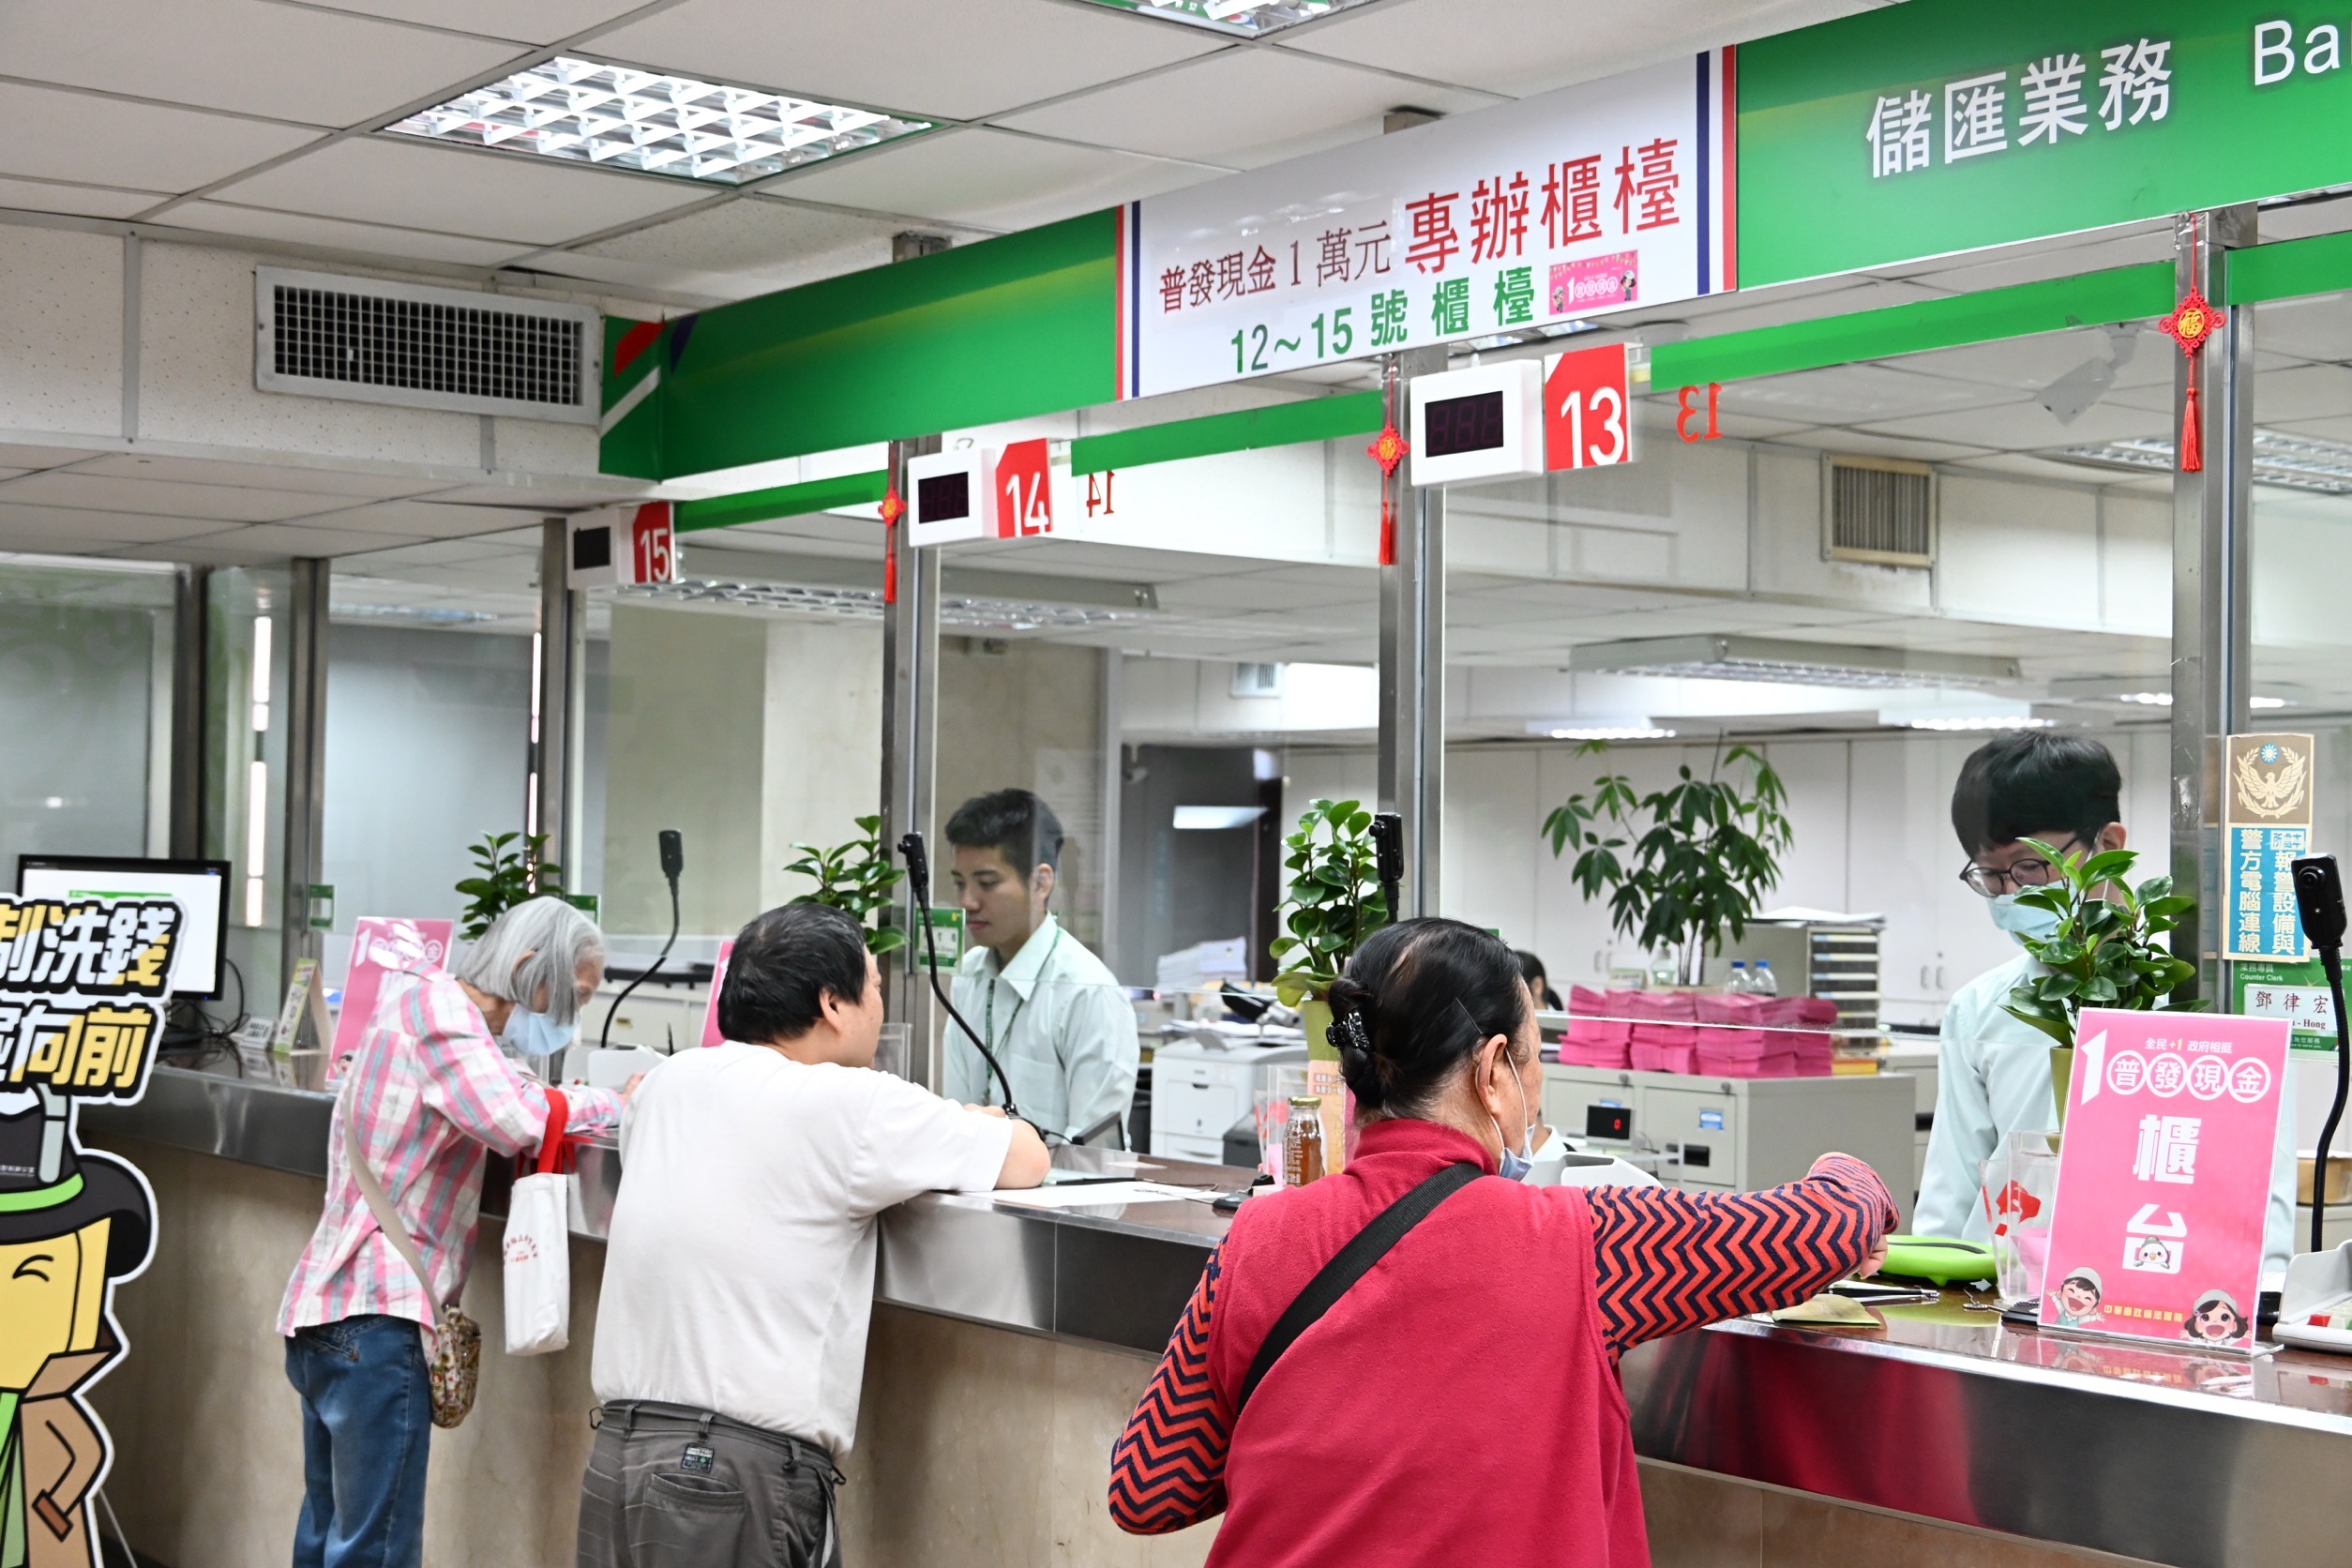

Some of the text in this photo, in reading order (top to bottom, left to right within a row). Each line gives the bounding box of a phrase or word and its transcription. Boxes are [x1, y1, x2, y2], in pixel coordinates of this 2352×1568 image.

[2254, 19, 2352, 86] Ba
[1866, 38, 2173, 178] 儲匯業務
[1406, 137, 1680, 275] 專辦櫃檯
[1560, 385, 1625, 470] 13
[1005, 472, 1050, 537] 14
[641, 527, 672, 582] 15
[2238, 829, 2263, 954] 警方電腦連線
[2271, 851, 2297, 956] 報警設備與
[2239, 972, 2284, 983] Counter Clerk
[2255, 991, 2329, 1014] 鄧律宏
[2187, 1040, 2234, 1055] 政府相挺
[2303, 1018, 2327, 1031] Hong
